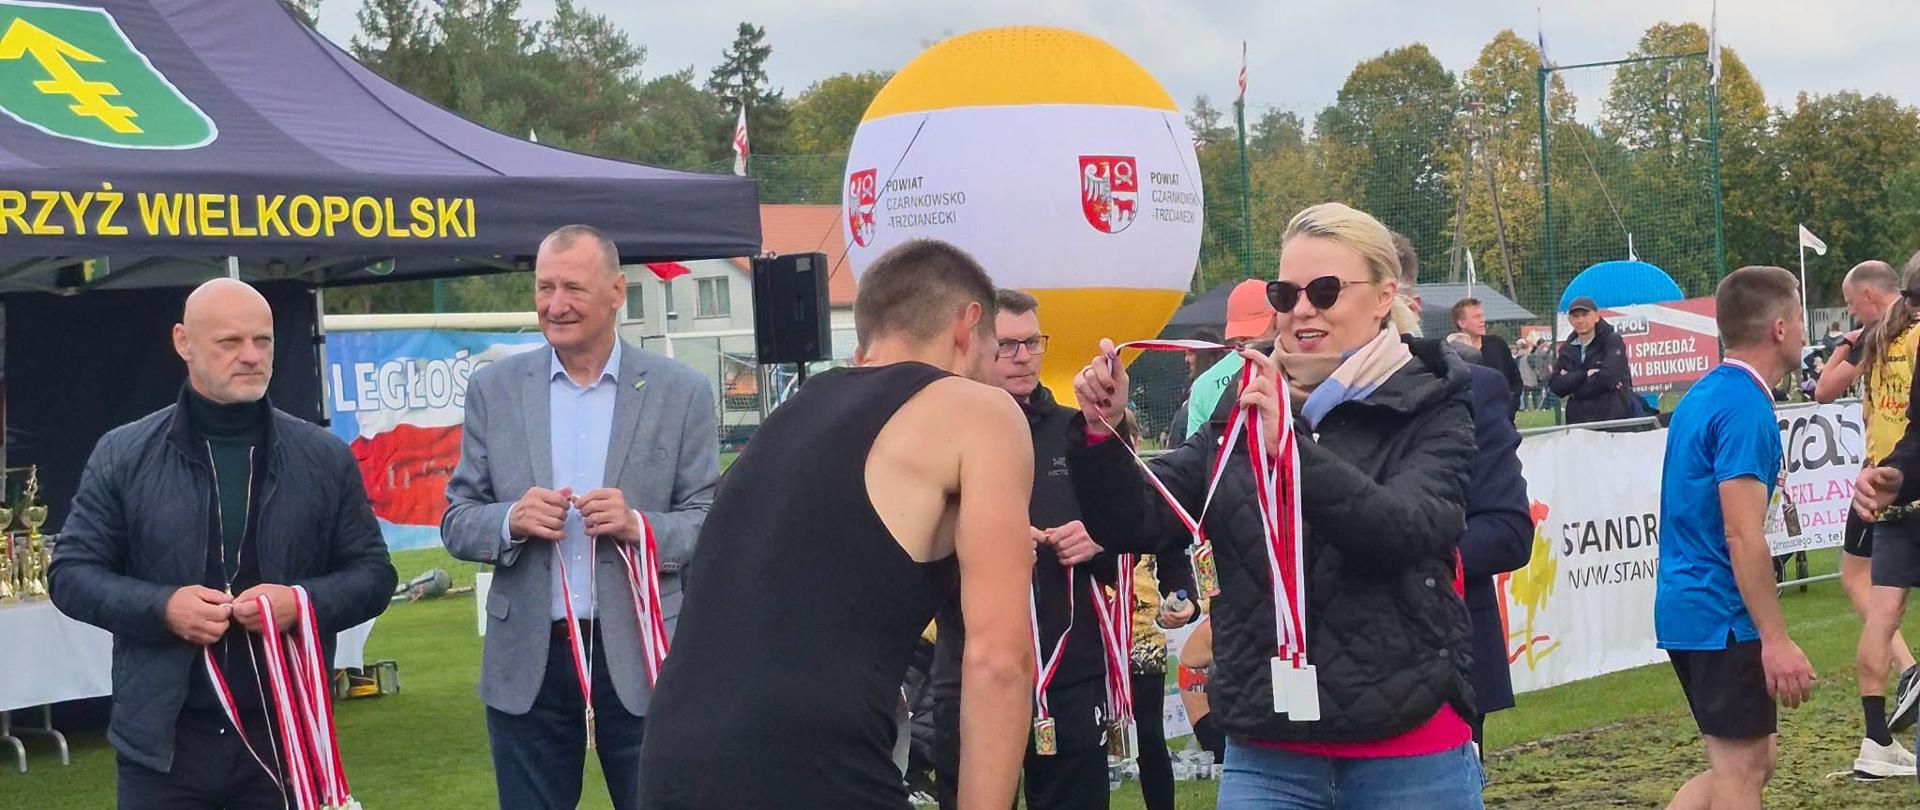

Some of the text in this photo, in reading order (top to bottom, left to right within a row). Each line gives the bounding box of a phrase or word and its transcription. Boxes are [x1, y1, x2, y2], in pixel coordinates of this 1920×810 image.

[885, 176, 924, 193] POWIAT
[1150, 171, 1180, 186] POWIAT
[885, 191, 967, 211] CZARNKOWSKO
[137, 191, 477, 239] WIELKOPOLSKI
[888, 210, 957, 229] -TRZCIANECKI
[1635, 335, 1697, 358] SPRZEDAŻ
[1645, 355, 1709, 377] BRUKOWEJ
[1562, 513, 1659, 557] STANDR
